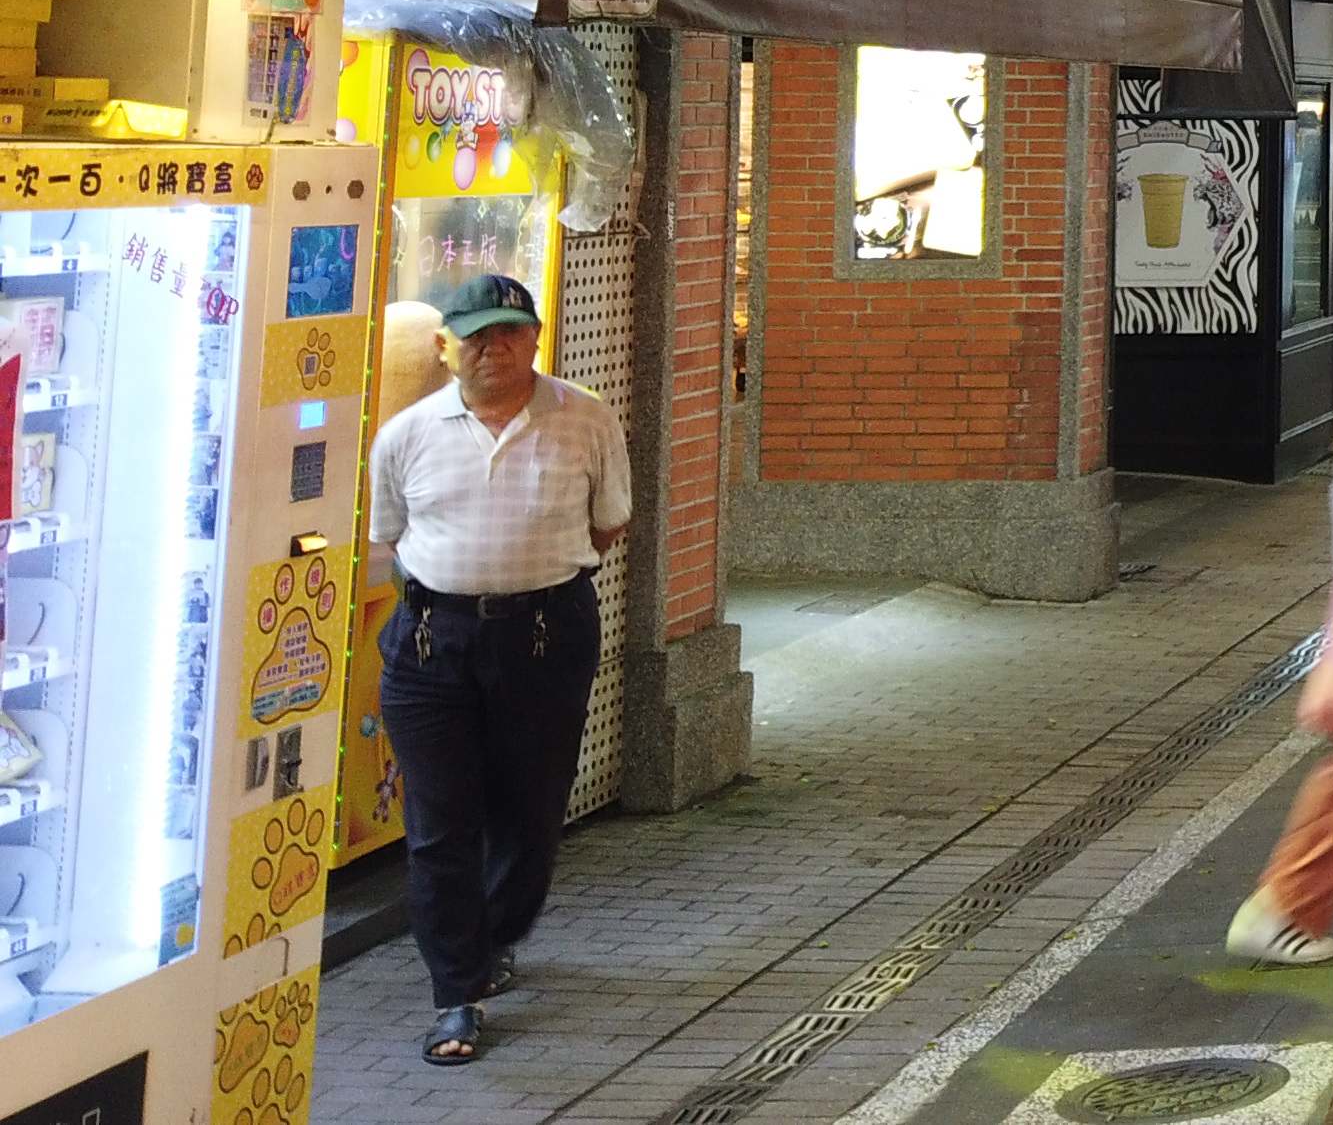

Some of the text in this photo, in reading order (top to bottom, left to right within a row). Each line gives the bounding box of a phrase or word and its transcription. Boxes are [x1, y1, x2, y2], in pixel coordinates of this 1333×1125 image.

[412, 68, 471, 125] TOY
[0, 161, 234, 198] 次一百·Q將寶盒
[419, 232, 500, 277] 日本正版
